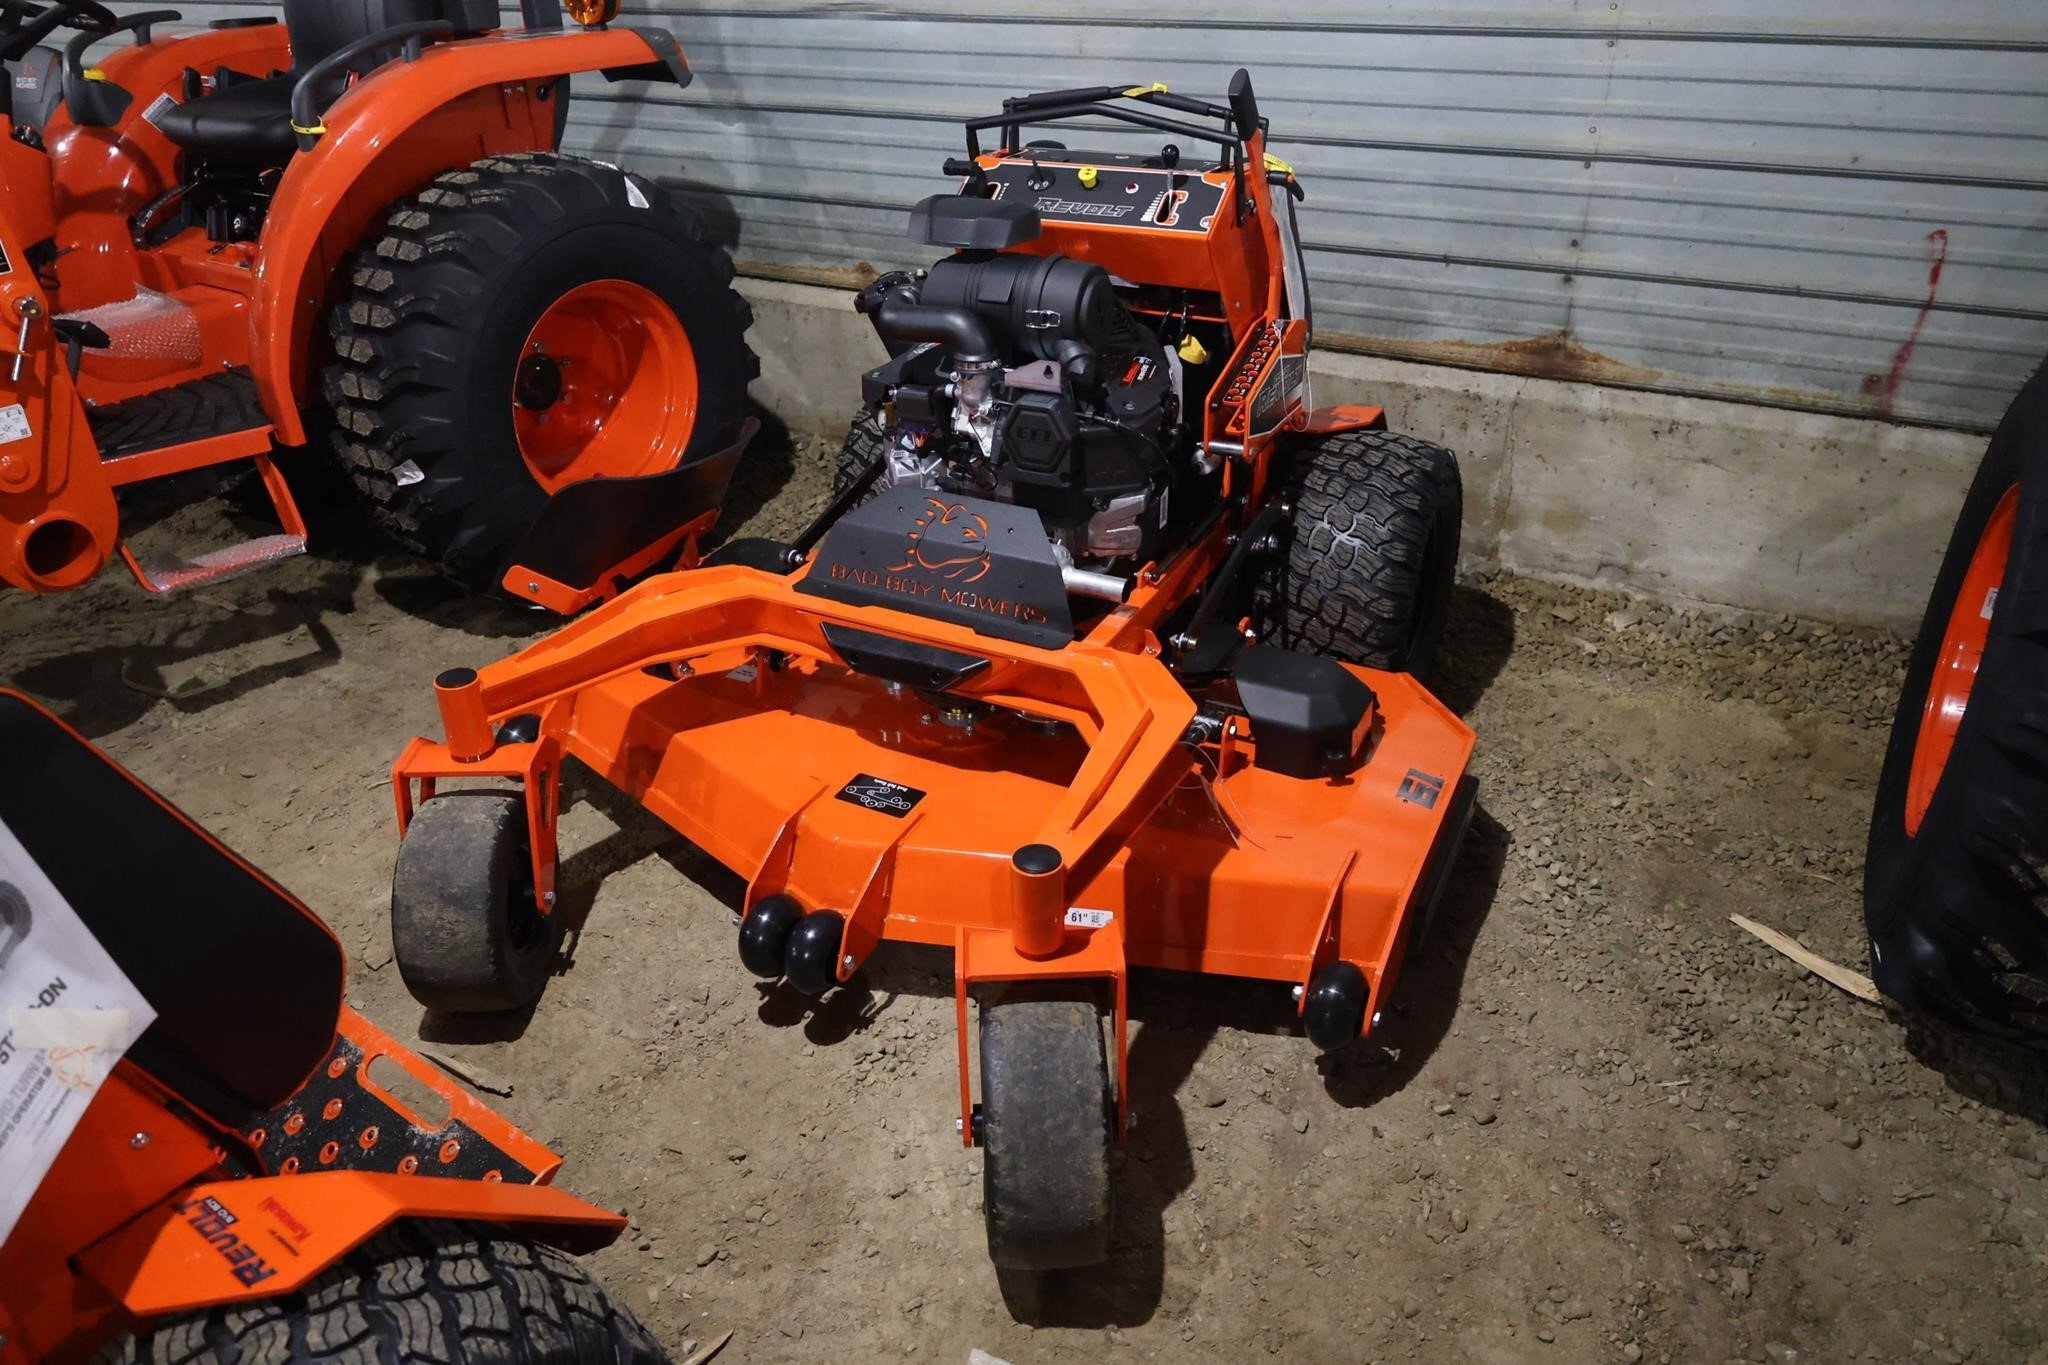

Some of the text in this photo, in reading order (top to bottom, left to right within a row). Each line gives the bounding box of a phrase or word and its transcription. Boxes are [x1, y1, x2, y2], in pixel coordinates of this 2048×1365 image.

[1034, 197, 1134, 217] REVOLT
[831, 561, 878, 586] BAD
[885, 574, 935, 597] BOY
[171, 1200, 277, 1288] REVOLT
